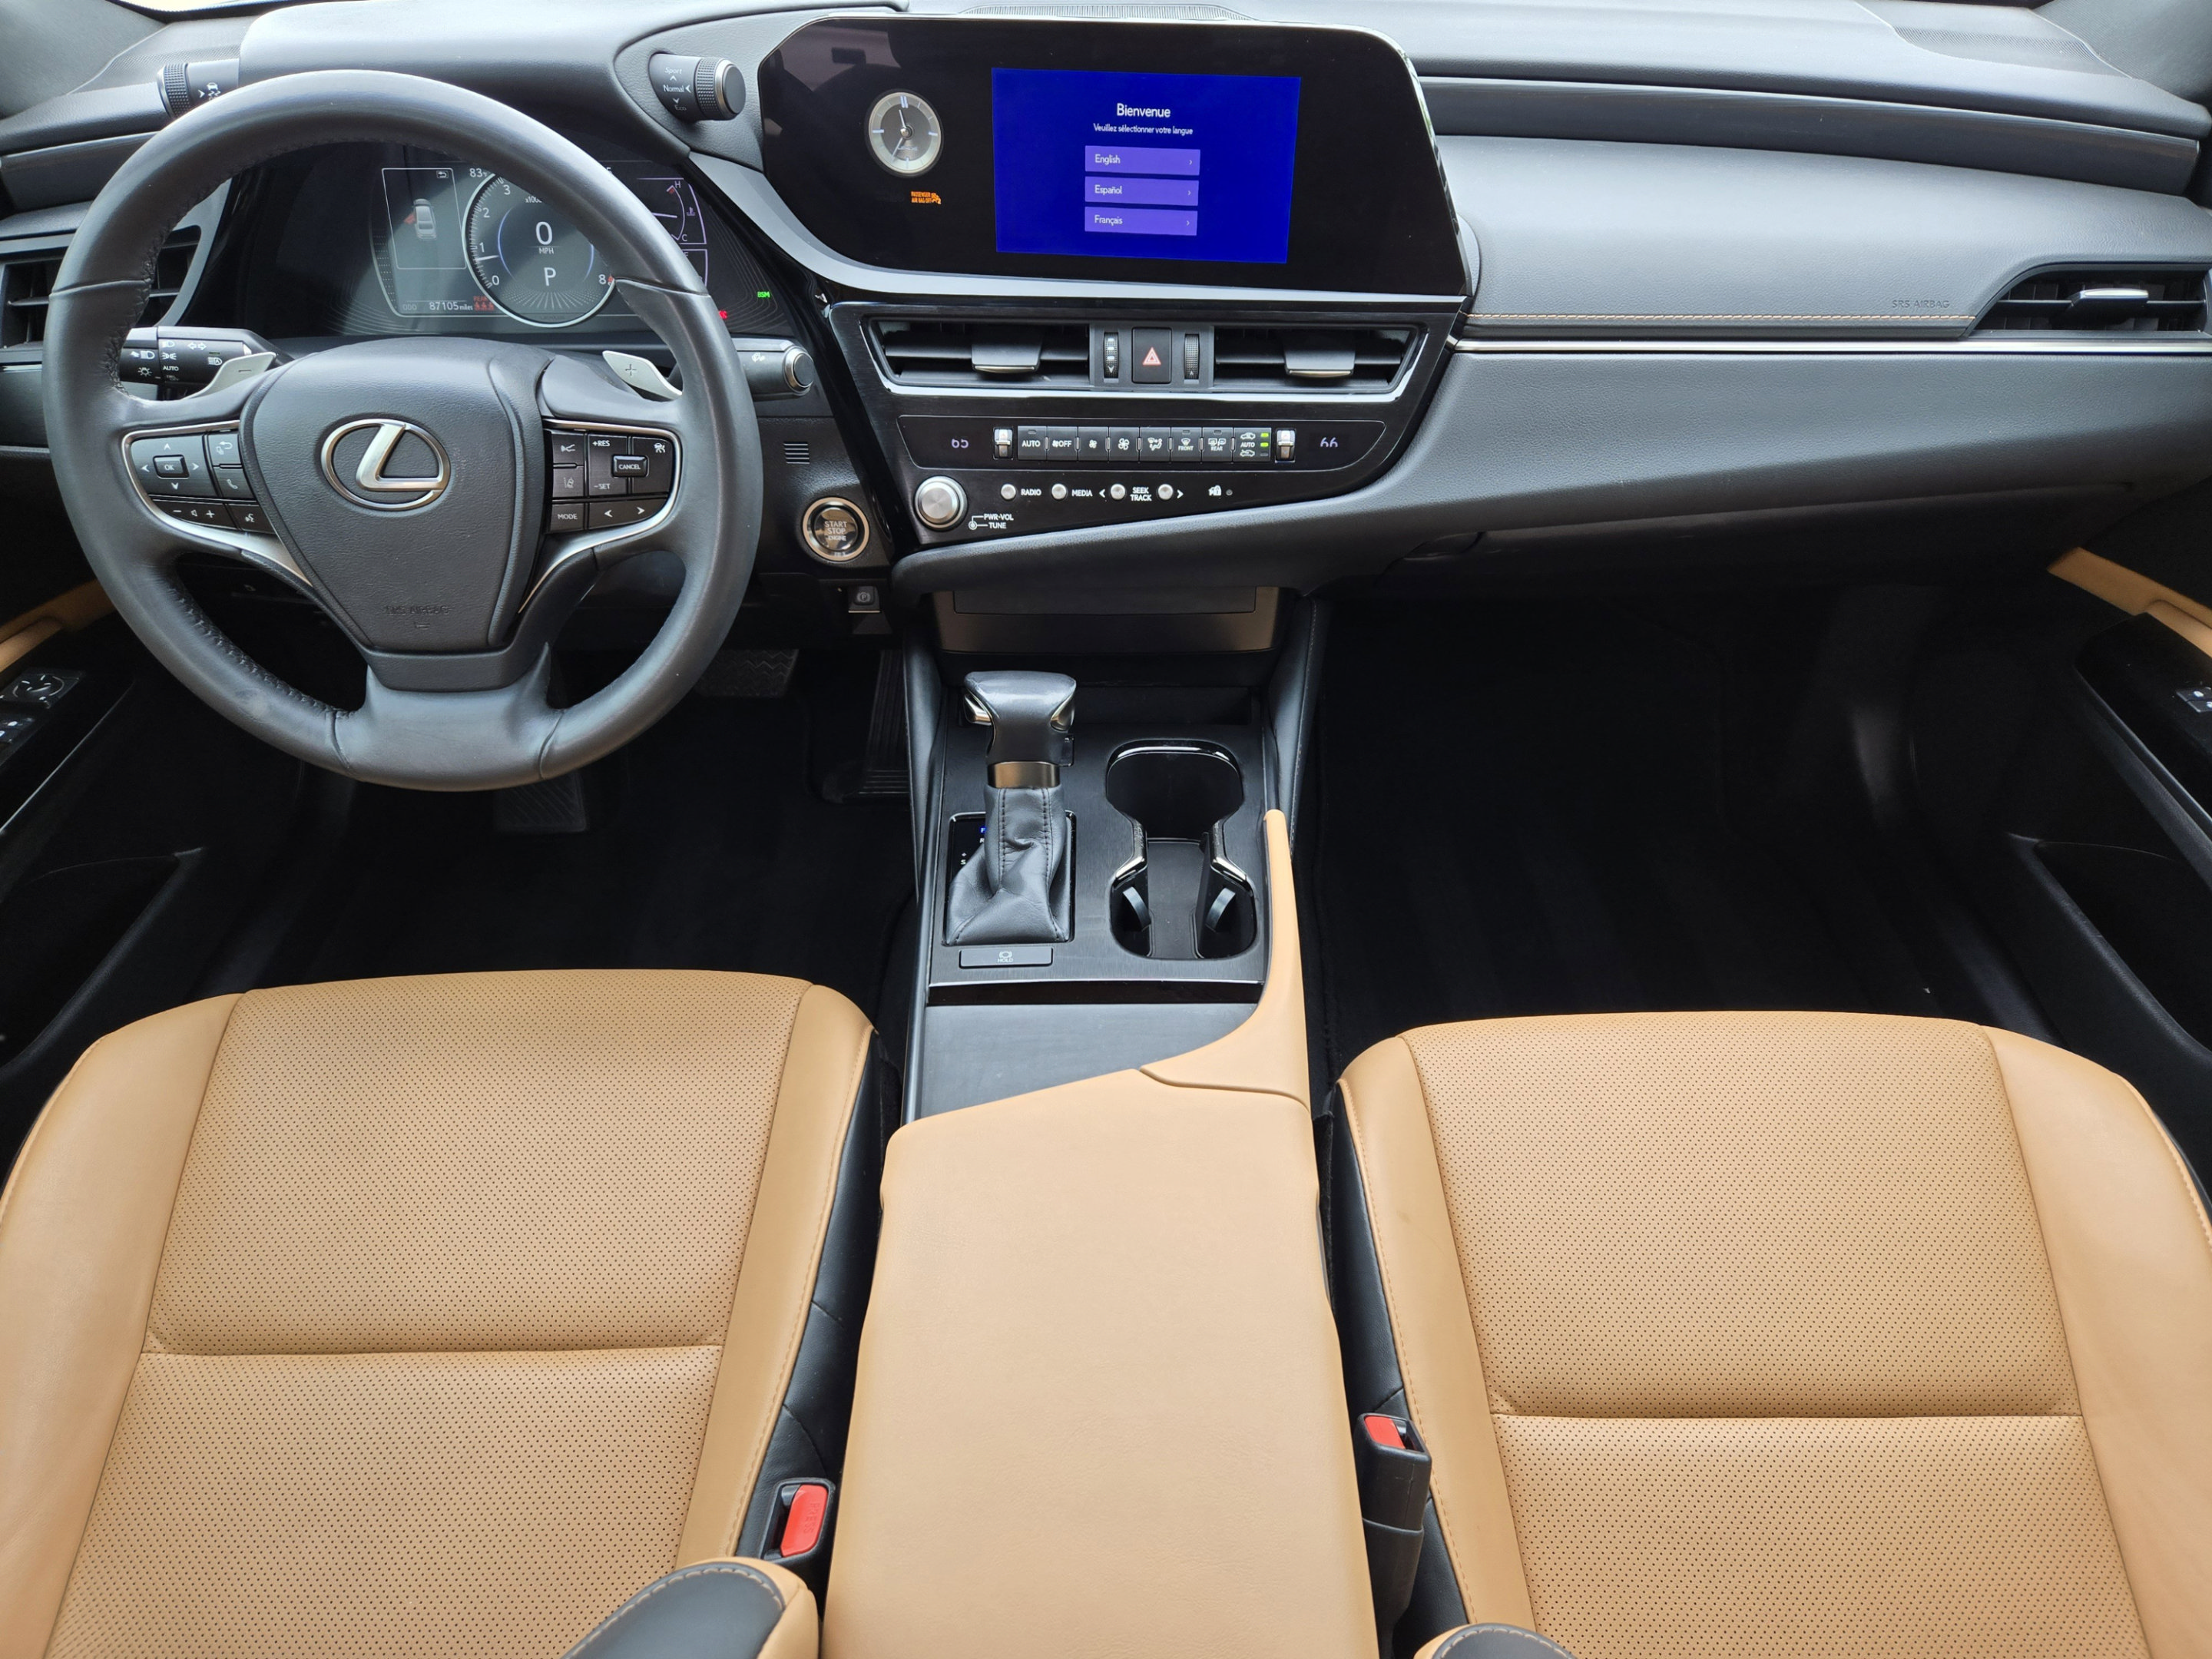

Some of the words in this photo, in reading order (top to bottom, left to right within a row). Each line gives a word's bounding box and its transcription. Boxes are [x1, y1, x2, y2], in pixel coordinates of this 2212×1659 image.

[663, 84, 685, 93] Normal
[1117, 103, 1171, 118] Bienvenue
[1093, 123, 1118, 132] Veuillez
[1118, 124, 1154, 134] sélectionner
[1155, 126, 1172, 134] votre
[1173, 126, 1194, 136] langue
[1094, 154, 1121, 165] English
[503, 184, 511, 195] 3
[675, 180, 681, 189] H
[1094, 184, 1123, 196] Español
[483, 207, 490, 217] 2
[1094, 214, 1123, 226] Français
[535, 221, 553, 245] 0
[682, 233, 688, 242] C
[479, 242, 485, 253] 1
[492, 275, 500, 286] 0
[544, 267, 557, 286] P
[598, 274, 607, 285] 8
[429, 302, 459, 311] 87105
[1892, 300, 1911, 308] SRS
[1914, 300, 1950, 308] AIRBAG
[803, 1502, 820, 1534] PRESS
